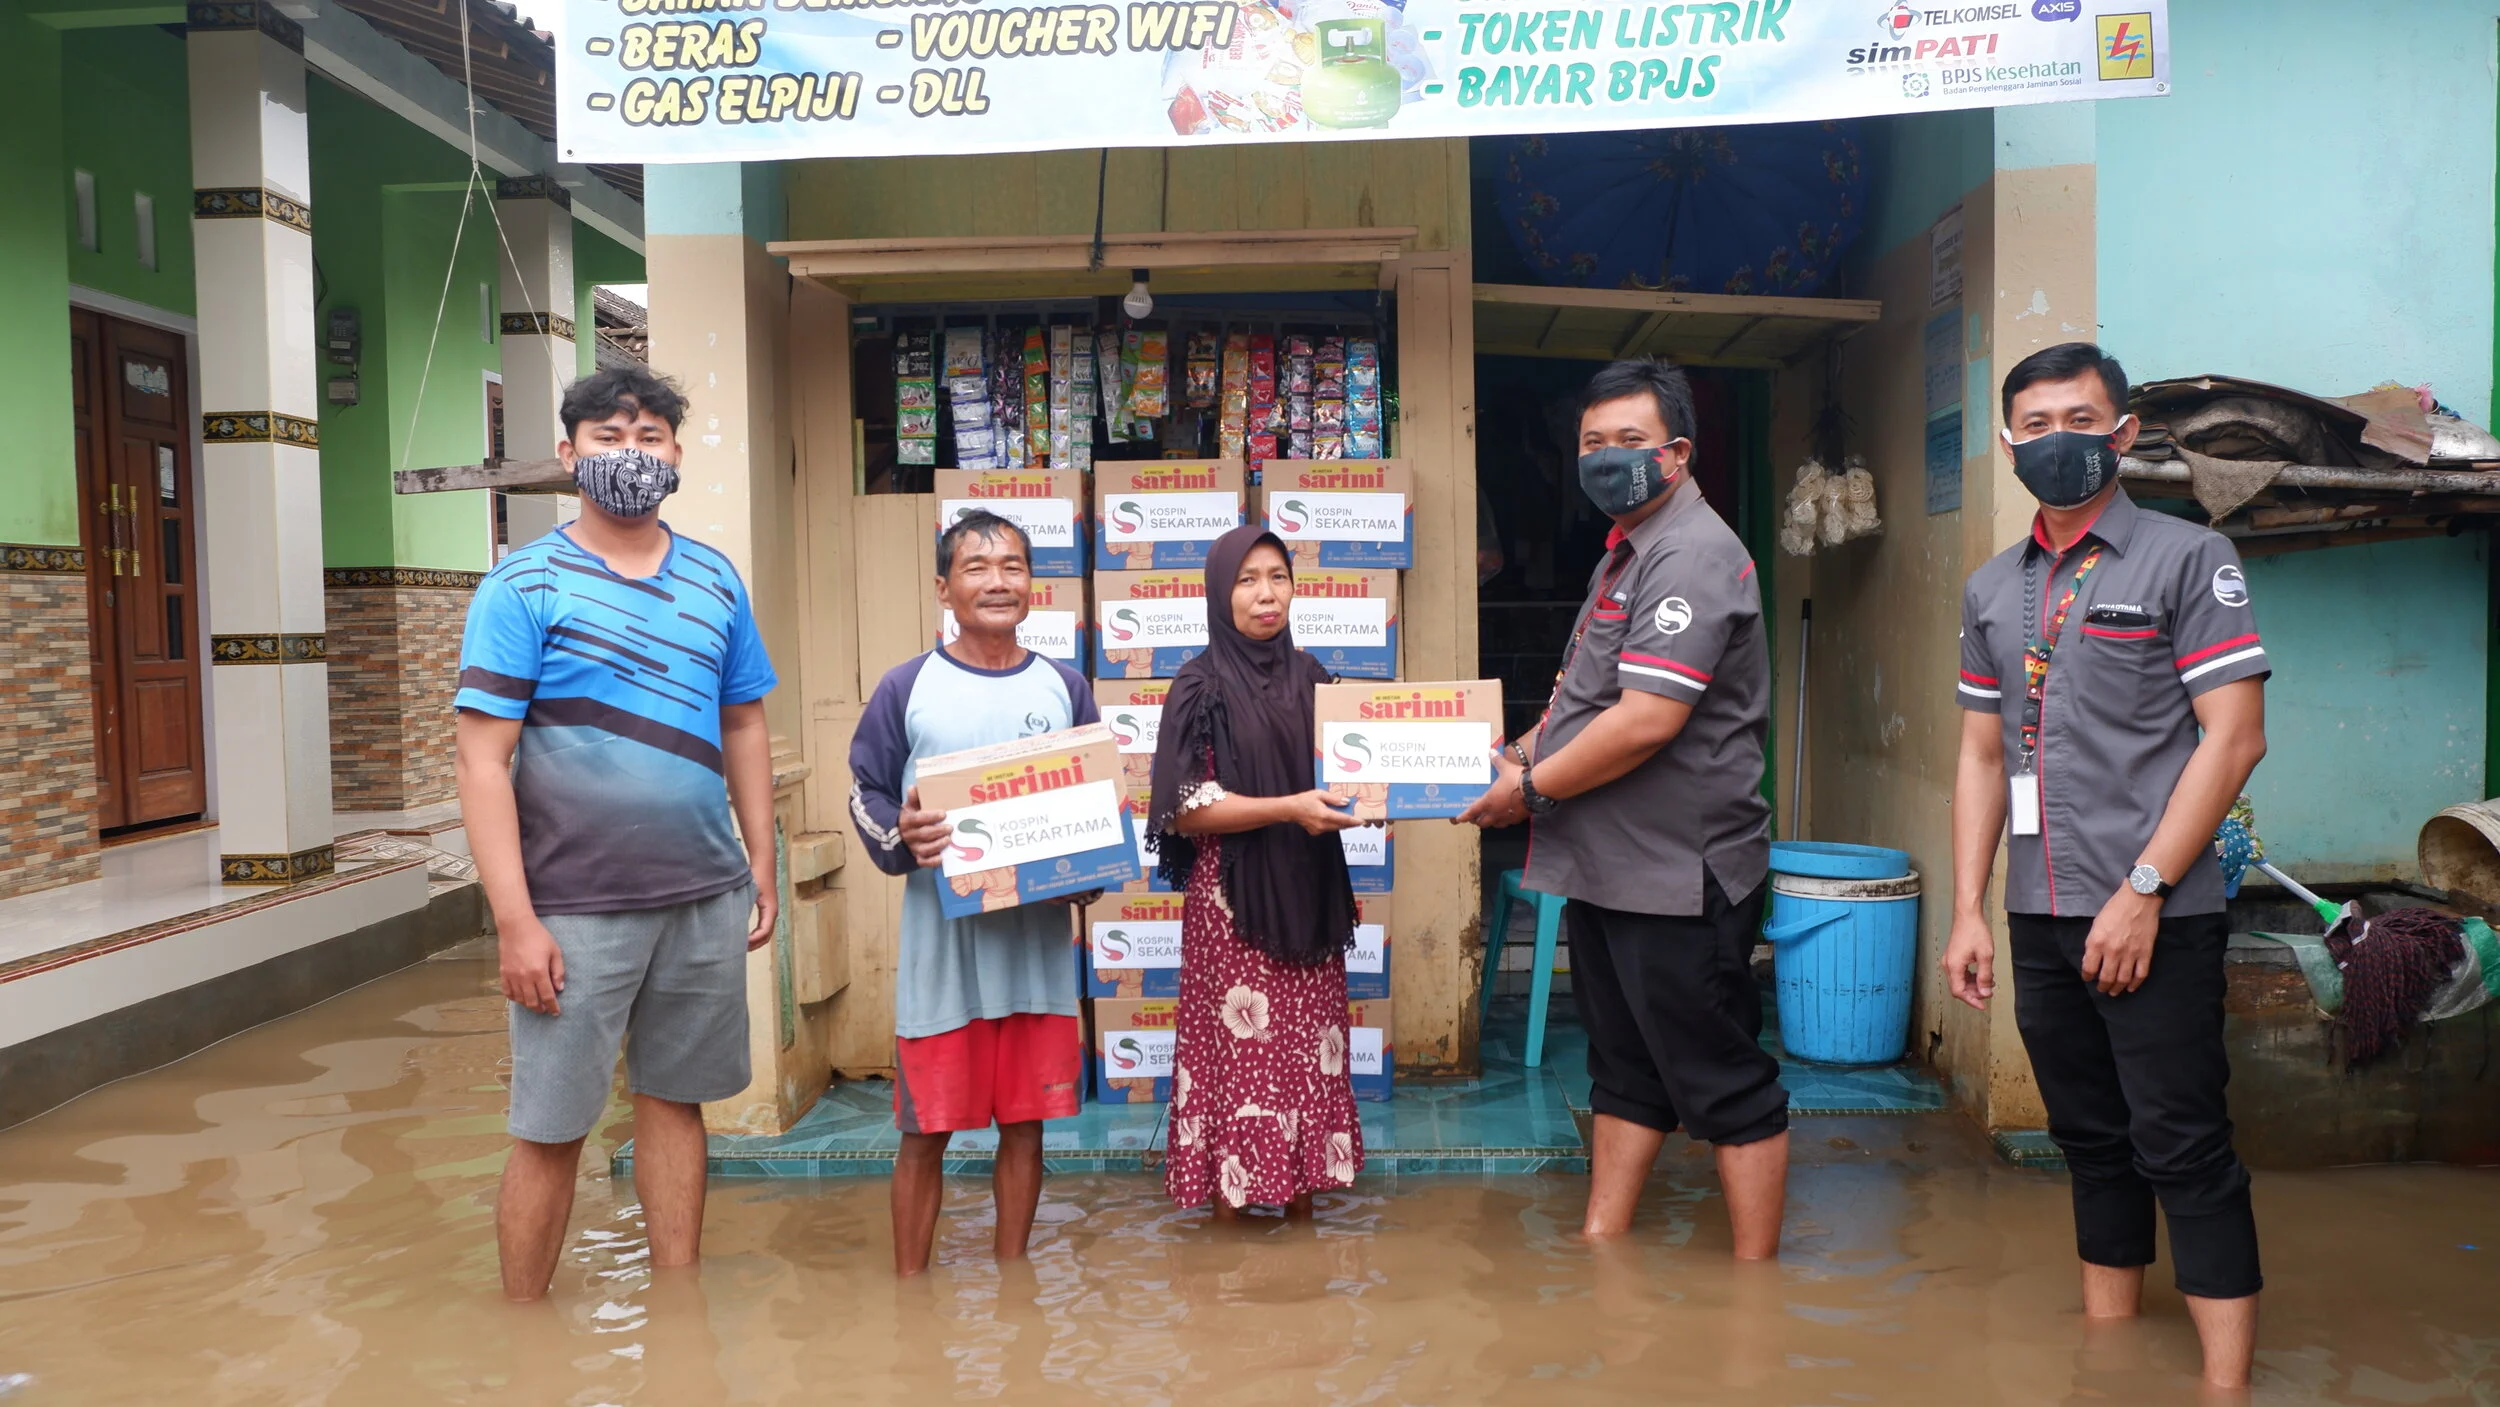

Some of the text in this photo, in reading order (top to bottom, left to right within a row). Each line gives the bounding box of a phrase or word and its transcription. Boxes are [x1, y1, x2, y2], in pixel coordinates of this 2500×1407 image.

[1924, 3, 2022, 26] TELKOMSEL
[2038, 1, 2075, 15] AXIS
[911, 5, 1119, 61] VOUCHER
[1128, 1, 1239, 51] WIFI
[1459, 10, 1602, 55] TOKEN
[1615, 0, 1791, 48] LISTRIK
[619, 18, 767, 72] BERAS
[1846, 33, 1999, 64] simPATI
[1458, 62, 1595, 107] BAYAR
[1608, 55, 1721, 101] BPJS
[1942, 61, 2081, 85] BPJS Kesehatan
[909, 67, 990, 117] DLL
[1943, 78, 2082, 95] Badan Penyelenggara Jaminan Sosial
[621, 76, 714, 127] GAS
[717, 72, 863, 124] ELPIJI
[968, 476, 1053, 498] sarimi
[1131, 468, 1217, 490] sarimi
[1299, 467, 1385, 489] sarimi
[1001, 514, 1023, 522] SPIN
[1149, 507, 1187, 517] KOSPIN
[1315, 507, 1353, 517] KOSPIN
[1026, 524, 1067, 535] RTAMA
[1150, 517, 1232, 529] SEKARTAMA
[1315, 517, 1398, 530] SEKARTAMA
[1130, 577, 1206, 598] sarim
[1295, 576, 1369, 598] arimi
[1145, 613, 1183, 622] KOSPIN
[1297, 613, 1335, 622] KOSPIN
[1147, 623, 1209, 635] SEKARTA
[1298, 623, 1380, 635] SEKARTAMA
[1016, 635, 1068, 646] ARTAMA
[1359, 691, 1466, 720] sarimi
[1380, 742, 1426, 752] KOSPIN
[1380, 755, 1482, 769] SEKARTAMA
[969, 755, 1086, 805] sarimi
[1000, 814, 1049, 833] KOSPIN
[1002, 816, 1112, 849] SEKARTAMA
[1137, 936, 1174, 945] KOSPIN
[1138, 946, 1180, 957] SEKAR
[1149, 1044, 1175, 1053] KOSP
